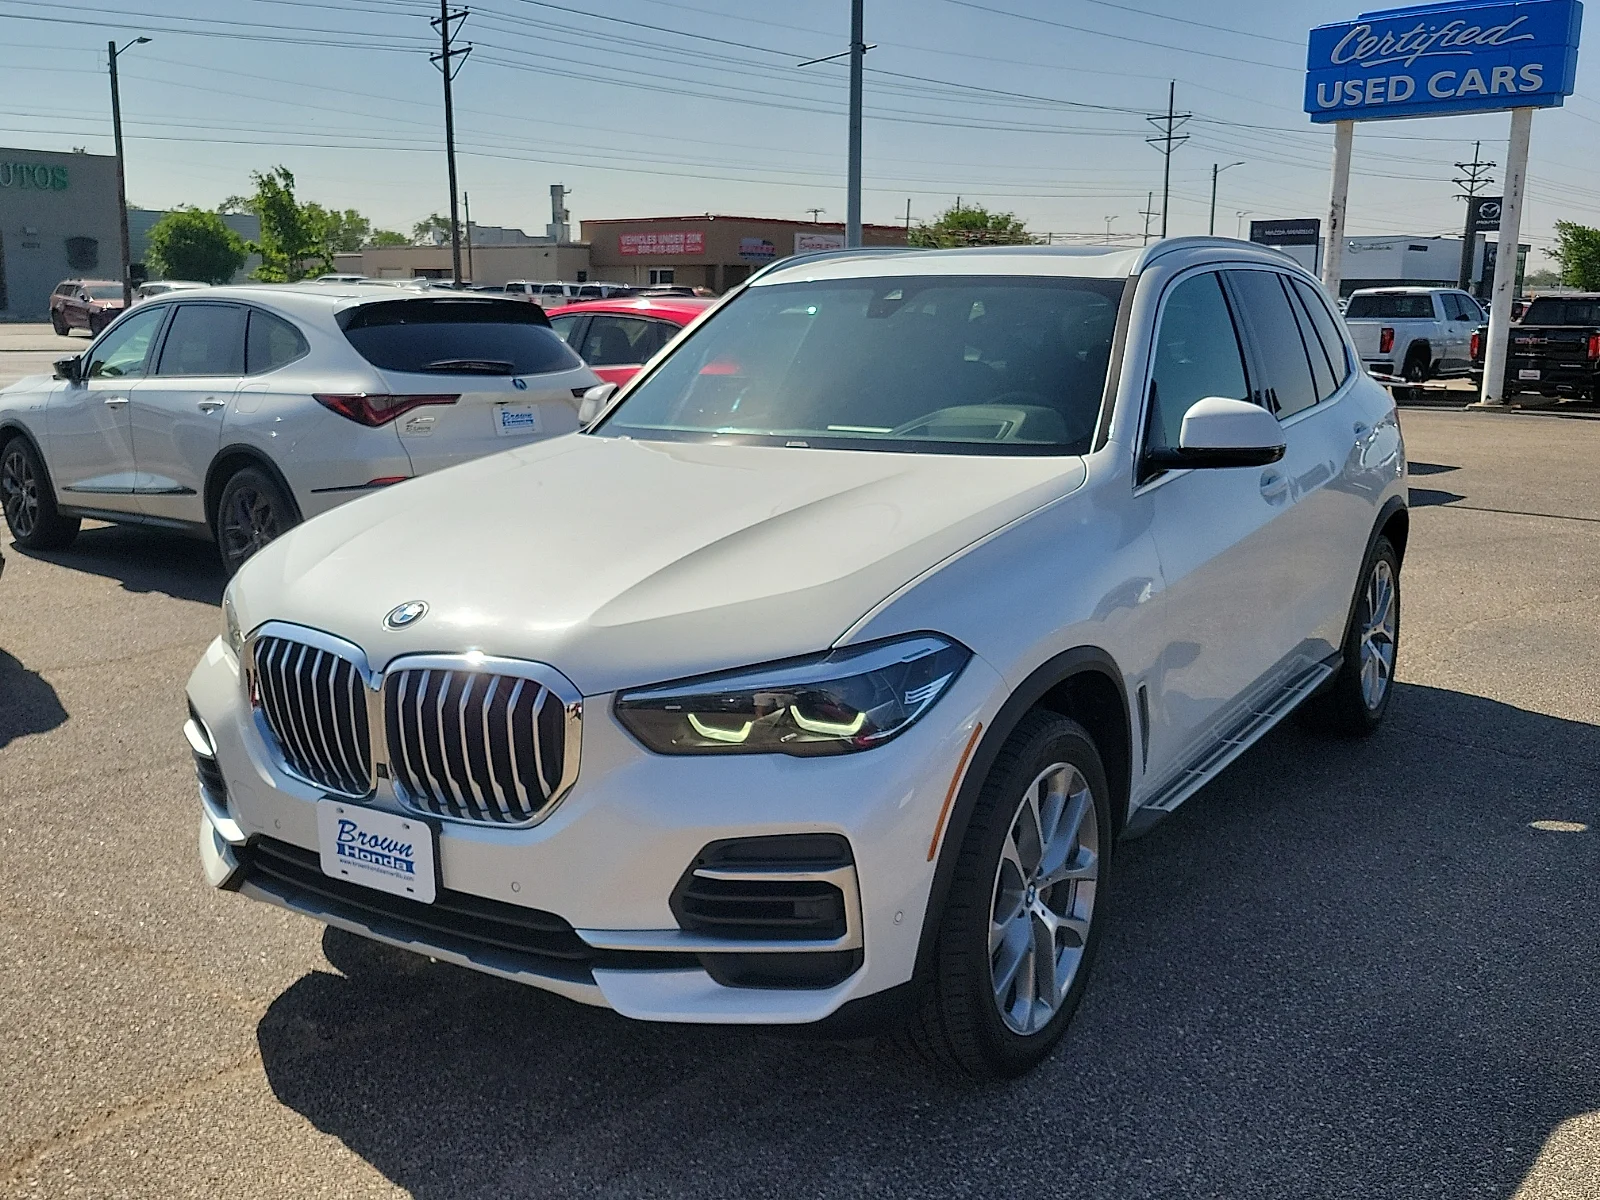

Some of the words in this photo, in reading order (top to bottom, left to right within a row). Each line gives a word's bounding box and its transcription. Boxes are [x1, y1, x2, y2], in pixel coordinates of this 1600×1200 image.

[1330, 15, 1535, 68] Certified
[1317, 75, 1416, 109] USED
[1427, 63, 1544, 99] CARS
[621, 235, 657, 245] VEHICLES
[658, 234, 684, 243] UNDER
[338, 819, 414, 857] Brown
[345, 844, 407, 871] Honda
